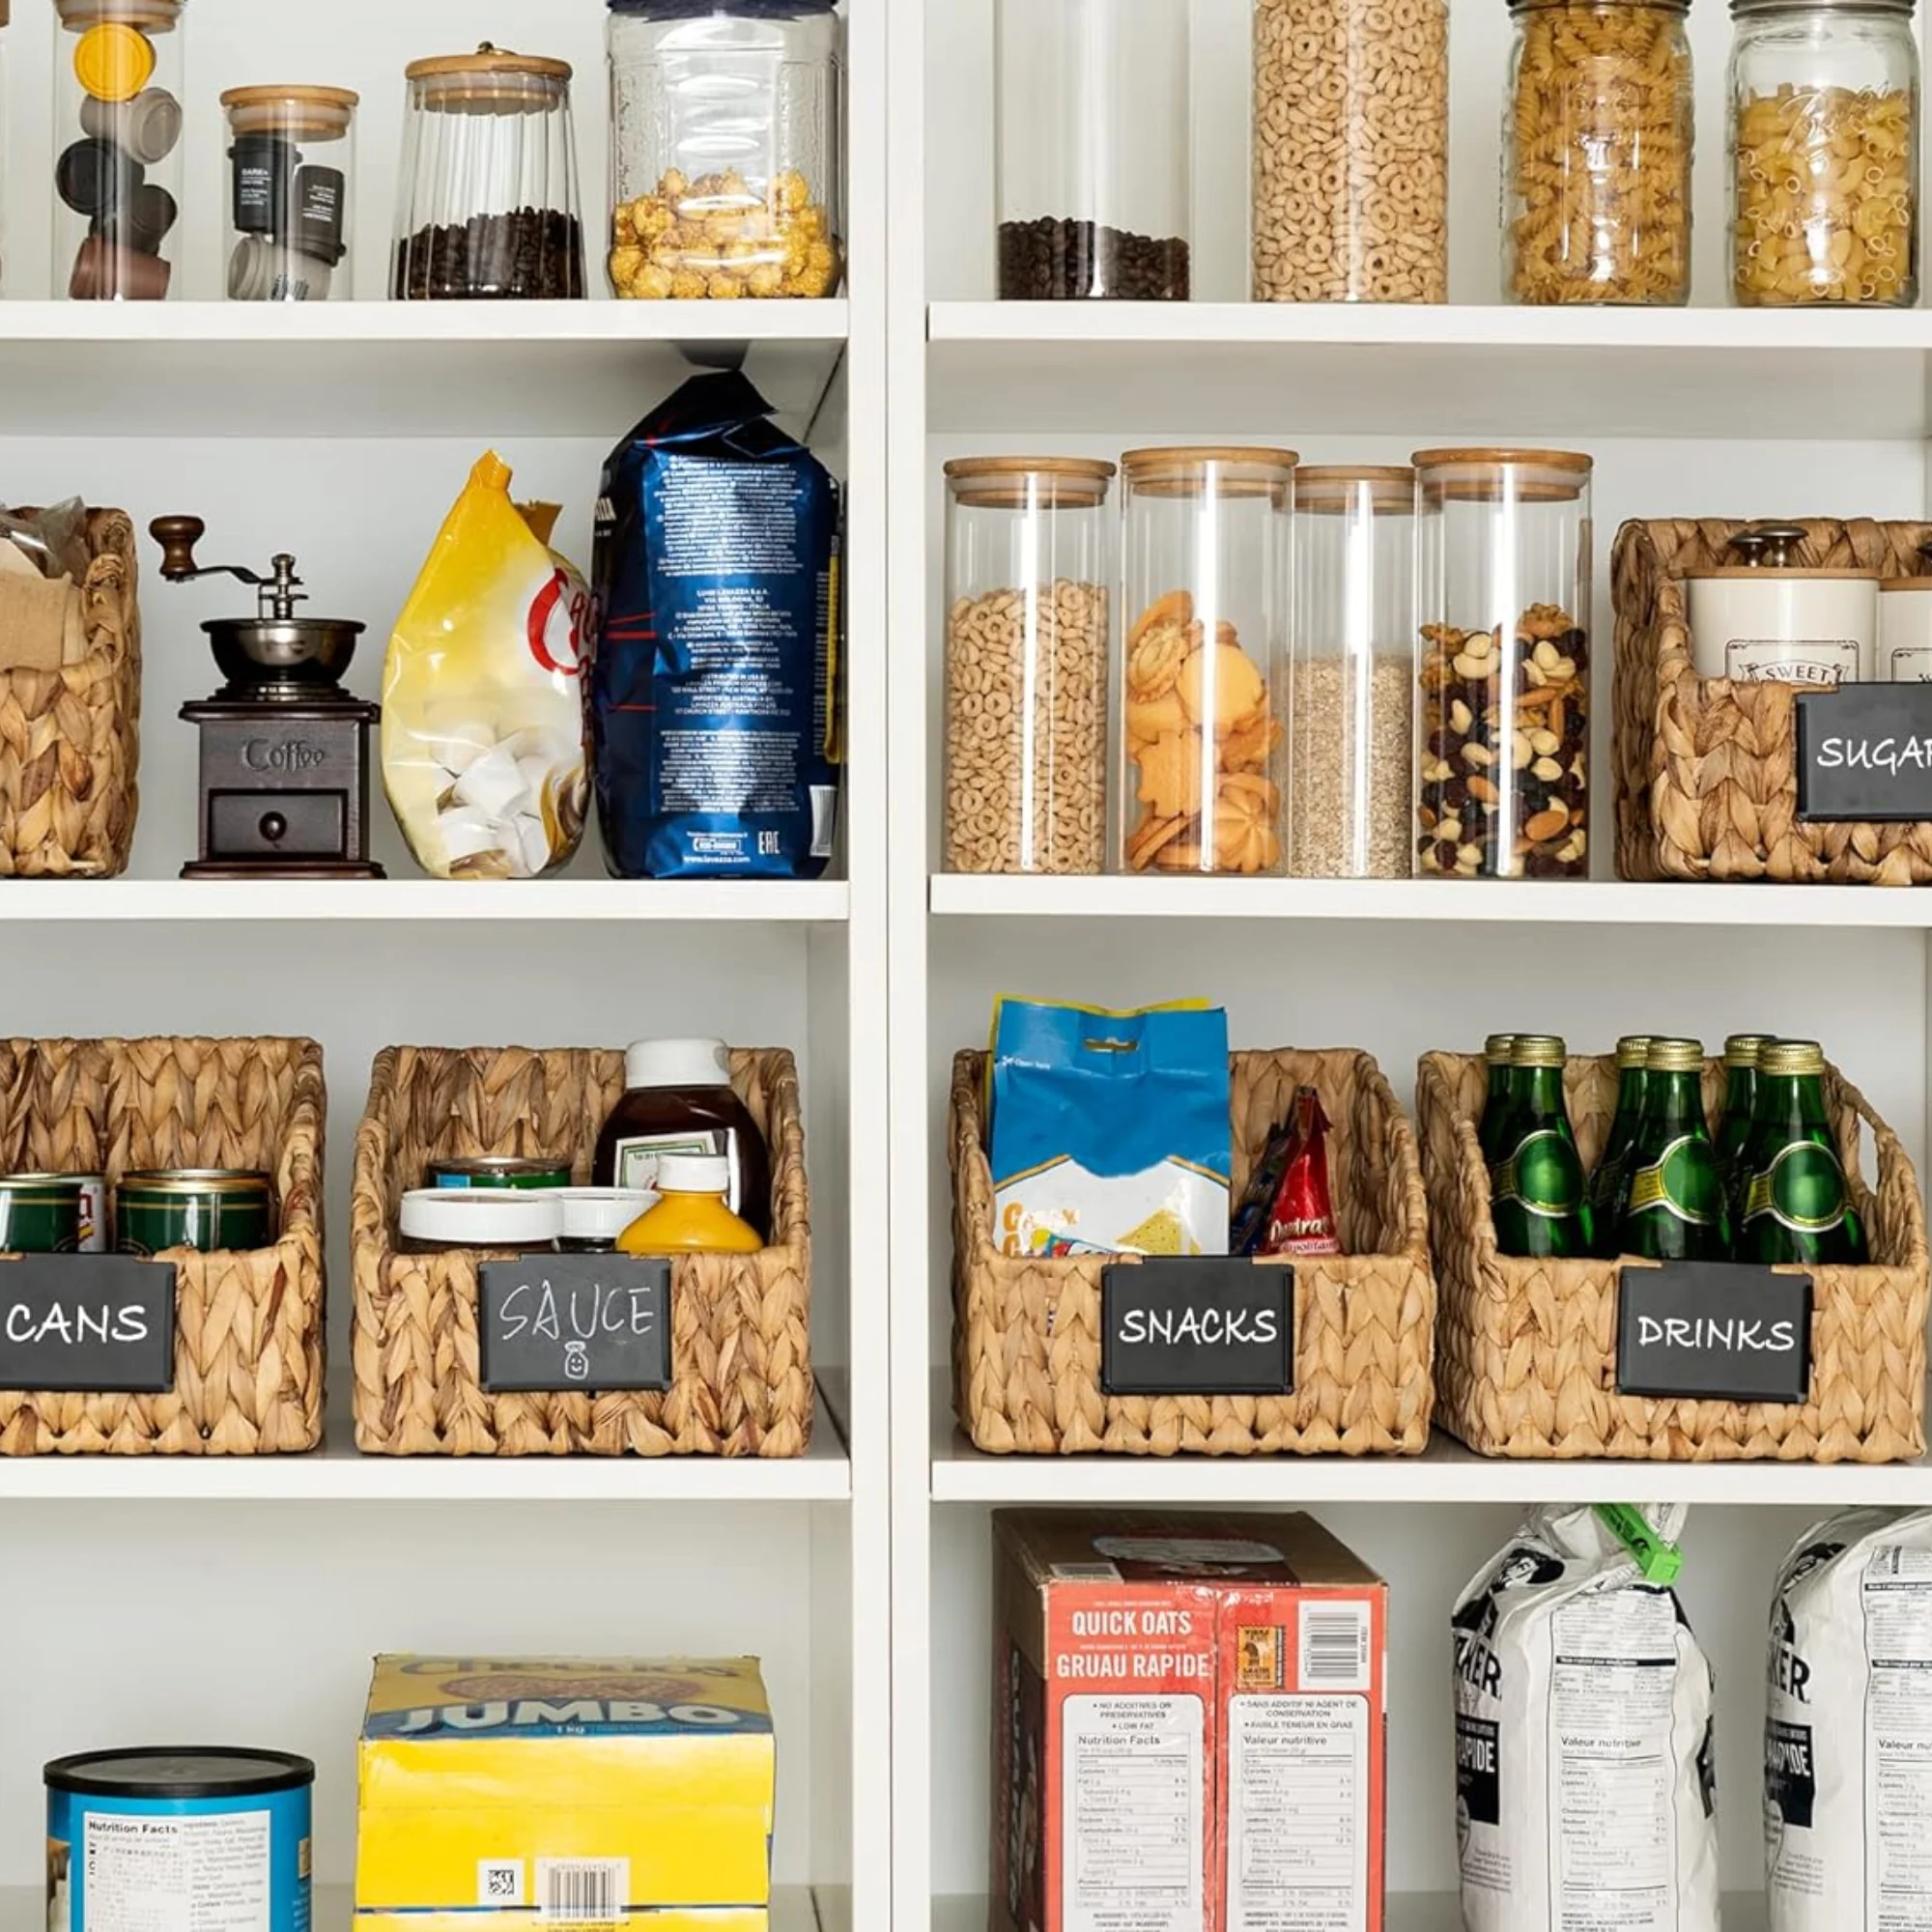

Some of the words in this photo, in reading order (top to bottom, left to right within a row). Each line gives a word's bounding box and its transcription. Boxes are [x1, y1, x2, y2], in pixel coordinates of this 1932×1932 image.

[1765, 664, 1829, 682] SWEET
[242, 737, 325, 773] Coffee
[498, 1280, 655, 1341] SAUCE
[6, 1303, 148, 1345] CANS
[1119, 1307, 1278, 1346] SNACKS
[1637, 1316, 1796, 1351] DRINKS
[1072, 1610, 1138, 1635] QUICK
[1142, 1610, 1192, 1635] OATS
[1057, 1653, 1127, 1677] GRUAU
[1133, 1653, 1210, 1677] RAPIDE
[393, 1700, 741, 1733] JUMBO
[1078, 1735, 1126, 1745] Nutrition
[1130, 1735, 1161, 1745] Facts
[1243, 1736, 1278, 1745] Valeur
[1281, 1736, 1327, 1745] nutritive
[1561, 1736, 1595, 1747] Valeur
[1878, 1739, 1913, 1749] Valeur
[89, 1821, 138, 1834] Nutrition
[142, 1824, 178, 1834] Facts
